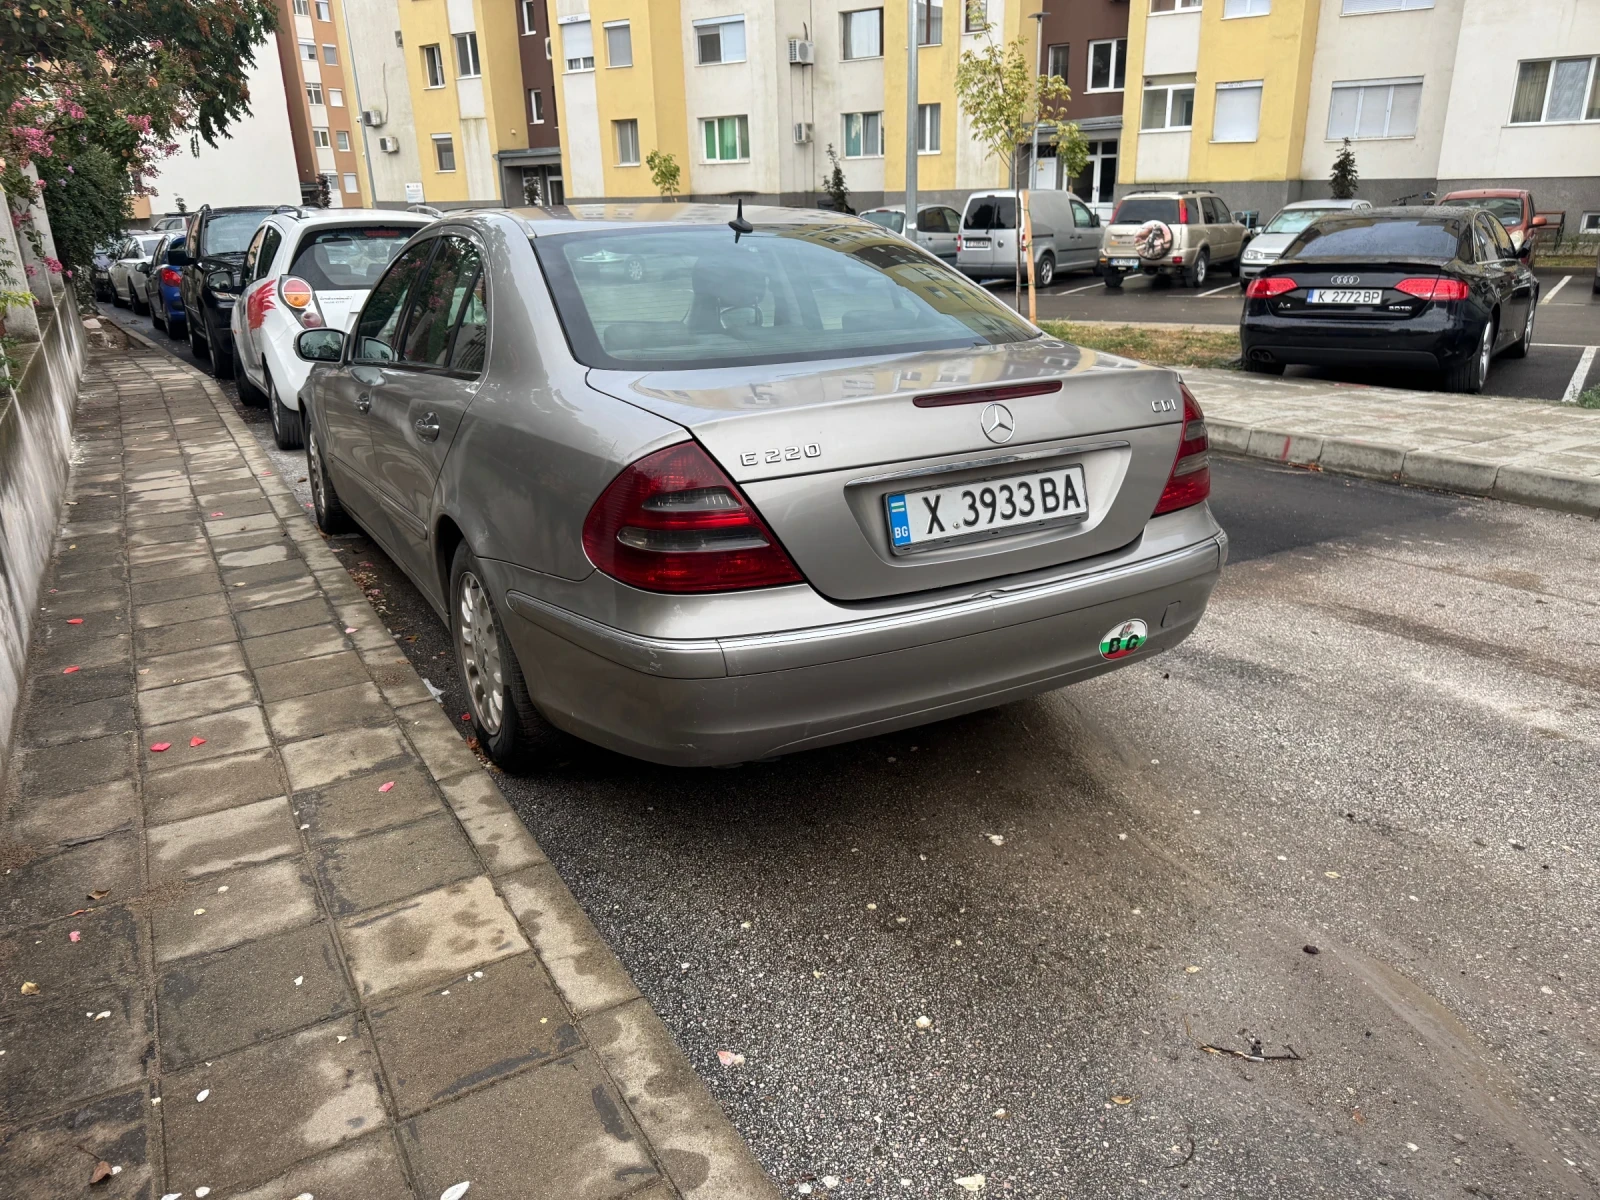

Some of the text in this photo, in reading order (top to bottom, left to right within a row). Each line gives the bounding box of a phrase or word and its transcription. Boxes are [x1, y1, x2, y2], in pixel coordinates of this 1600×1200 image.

[1318, 291, 1327, 303] K
[1332, 291, 1361, 303] 2772
[1151, 399, 1177, 413] CDI
[740, 443, 821, 467] E 220
[922, 474, 1082, 535] X 3933 BA
[894, 525, 909, 539] BG
[1108, 634, 1140, 654] BG
